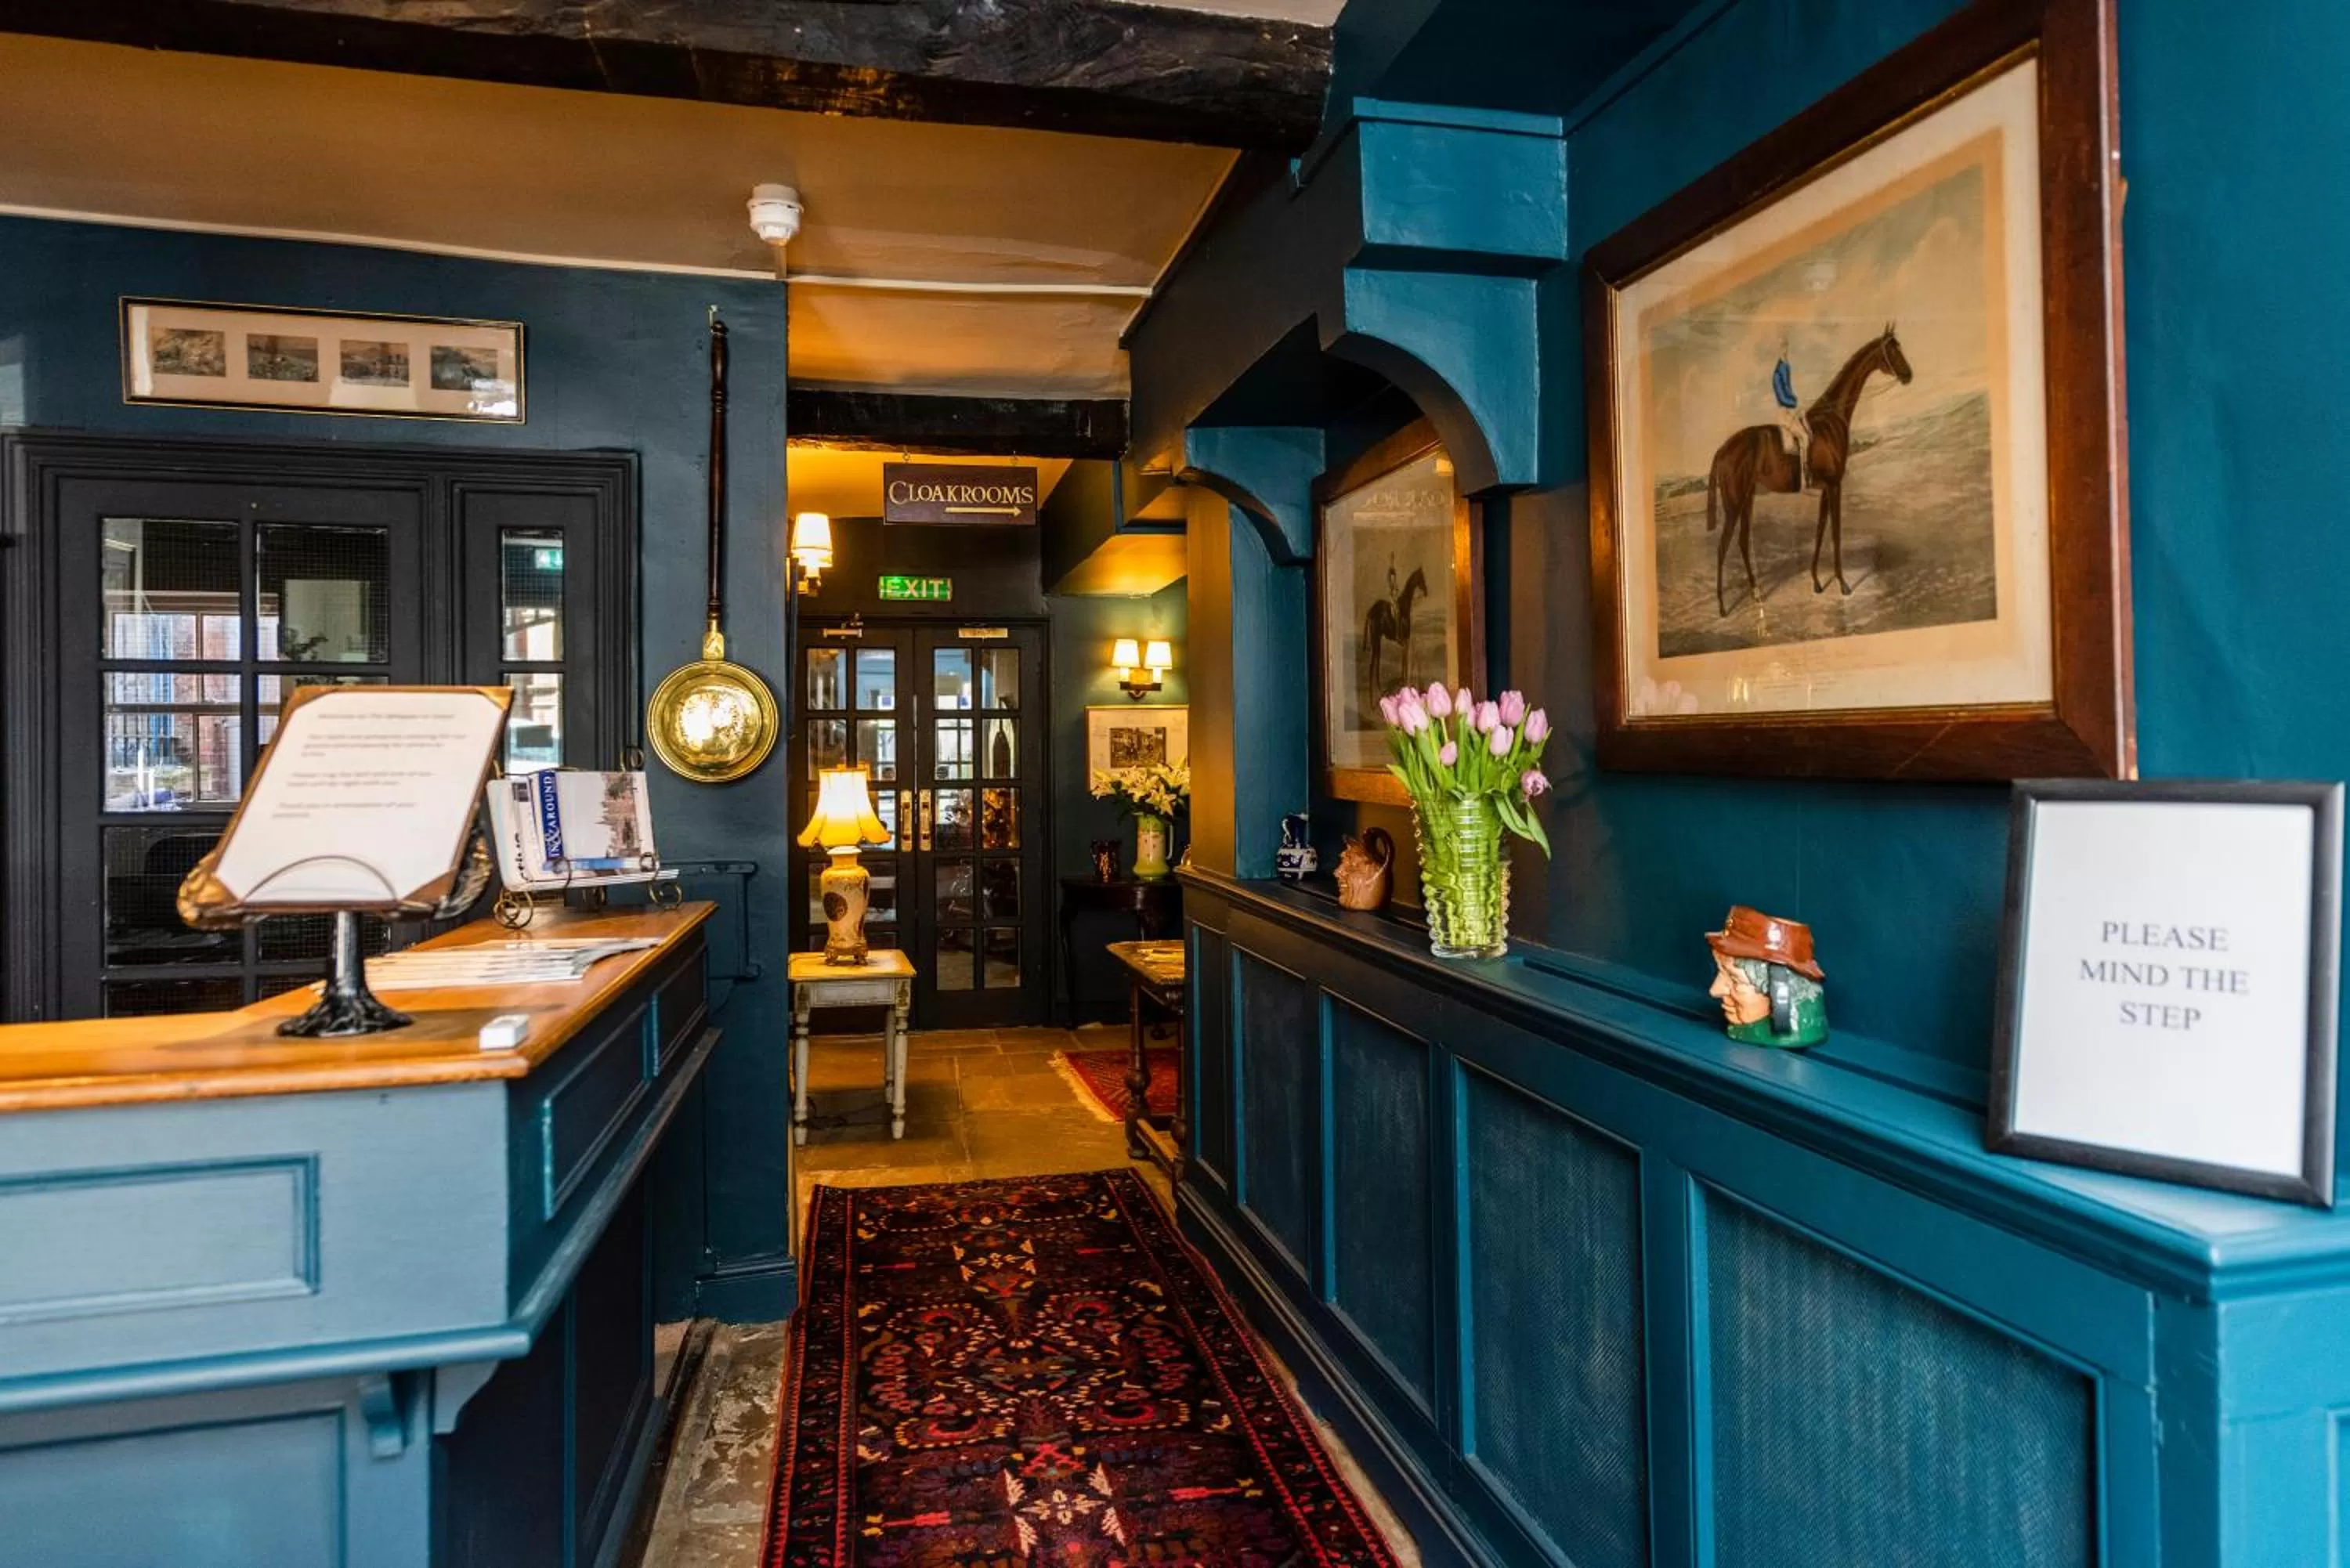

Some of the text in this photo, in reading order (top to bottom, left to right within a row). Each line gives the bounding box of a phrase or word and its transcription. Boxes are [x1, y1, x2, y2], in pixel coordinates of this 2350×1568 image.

[888, 480, 1034, 505] CLOAKROOMS
[886, 577, 944, 598] EXIT
[543, 776, 557, 828] AROUND
[2102, 920, 2229, 952] PLEASE
[2079, 958, 2250, 995] MIND THE
[2119, 1000, 2202, 1031] STEP
